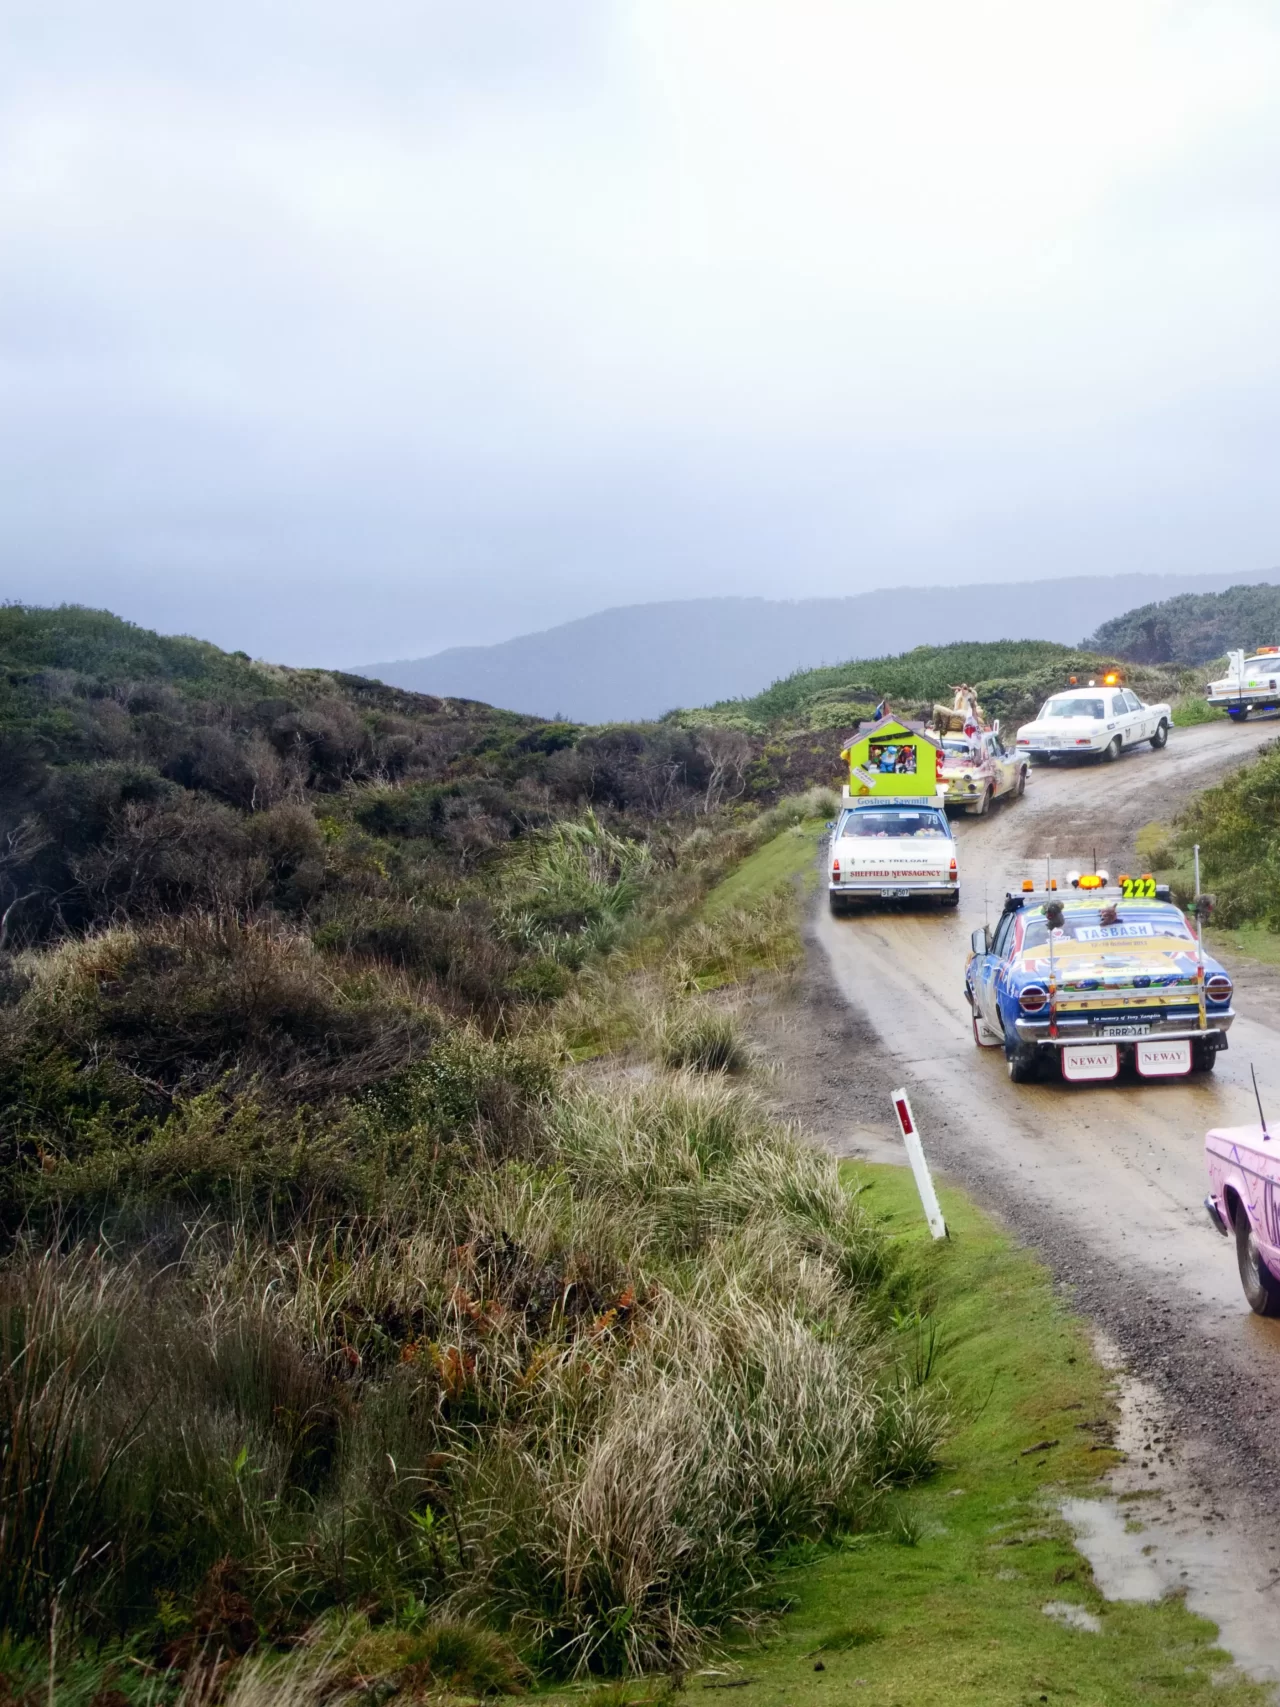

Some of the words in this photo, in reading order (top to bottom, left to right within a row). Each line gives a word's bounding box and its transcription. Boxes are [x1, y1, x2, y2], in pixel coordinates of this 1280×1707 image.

[857, 797, 890, 805] Goshen
[893, 797, 929, 805] Sawmill
[850, 870, 890, 878] SHEFFIELD
[892, 870, 941, 879] NEWSAGENCY
[1122, 878, 1156, 898] 222
[1083, 926, 1148, 939] TASBASH
[1070, 1056, 1110, 1067] NEWAY
[1144, 1052, 1183, 1062] NEWAY
